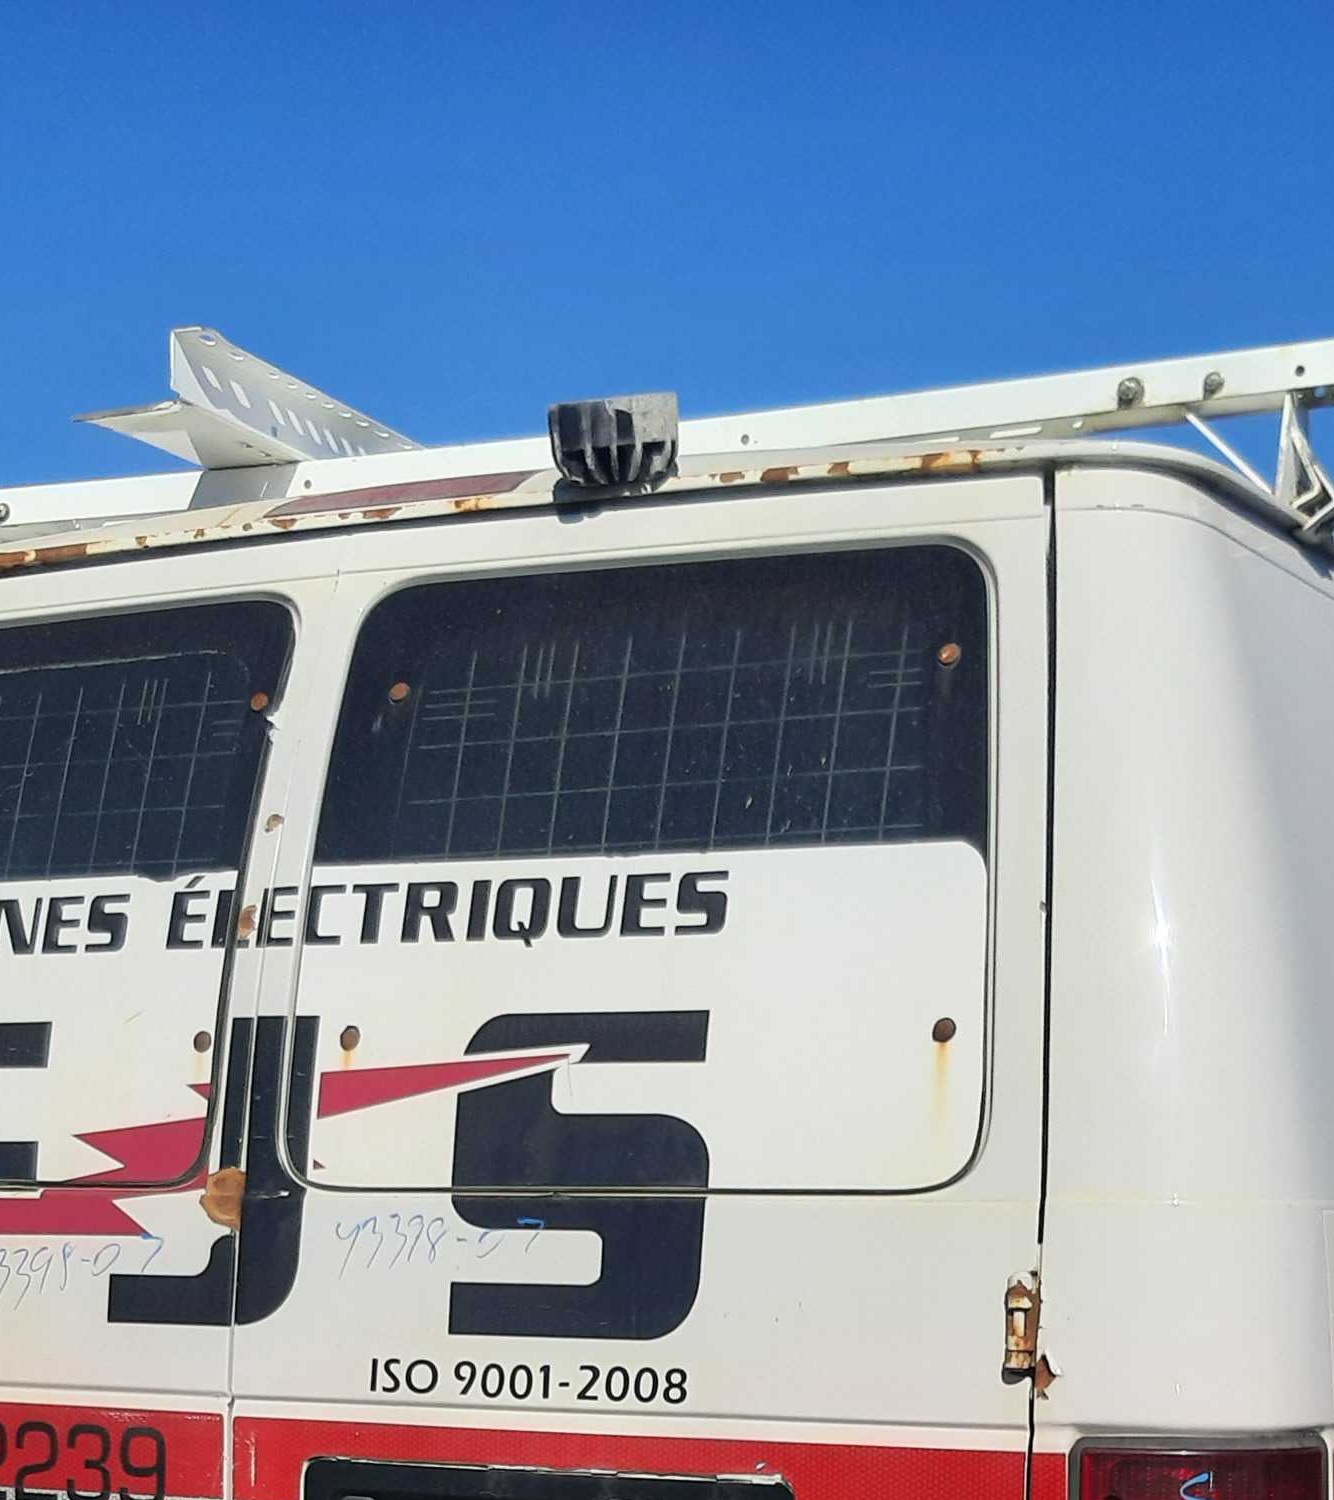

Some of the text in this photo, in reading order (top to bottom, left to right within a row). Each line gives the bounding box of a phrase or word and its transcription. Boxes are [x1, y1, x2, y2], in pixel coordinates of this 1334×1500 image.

[165, 869, 730, 951] ÉLECTRIQUES
[368, 1358, 690, 1405] ISO 9001-2008
